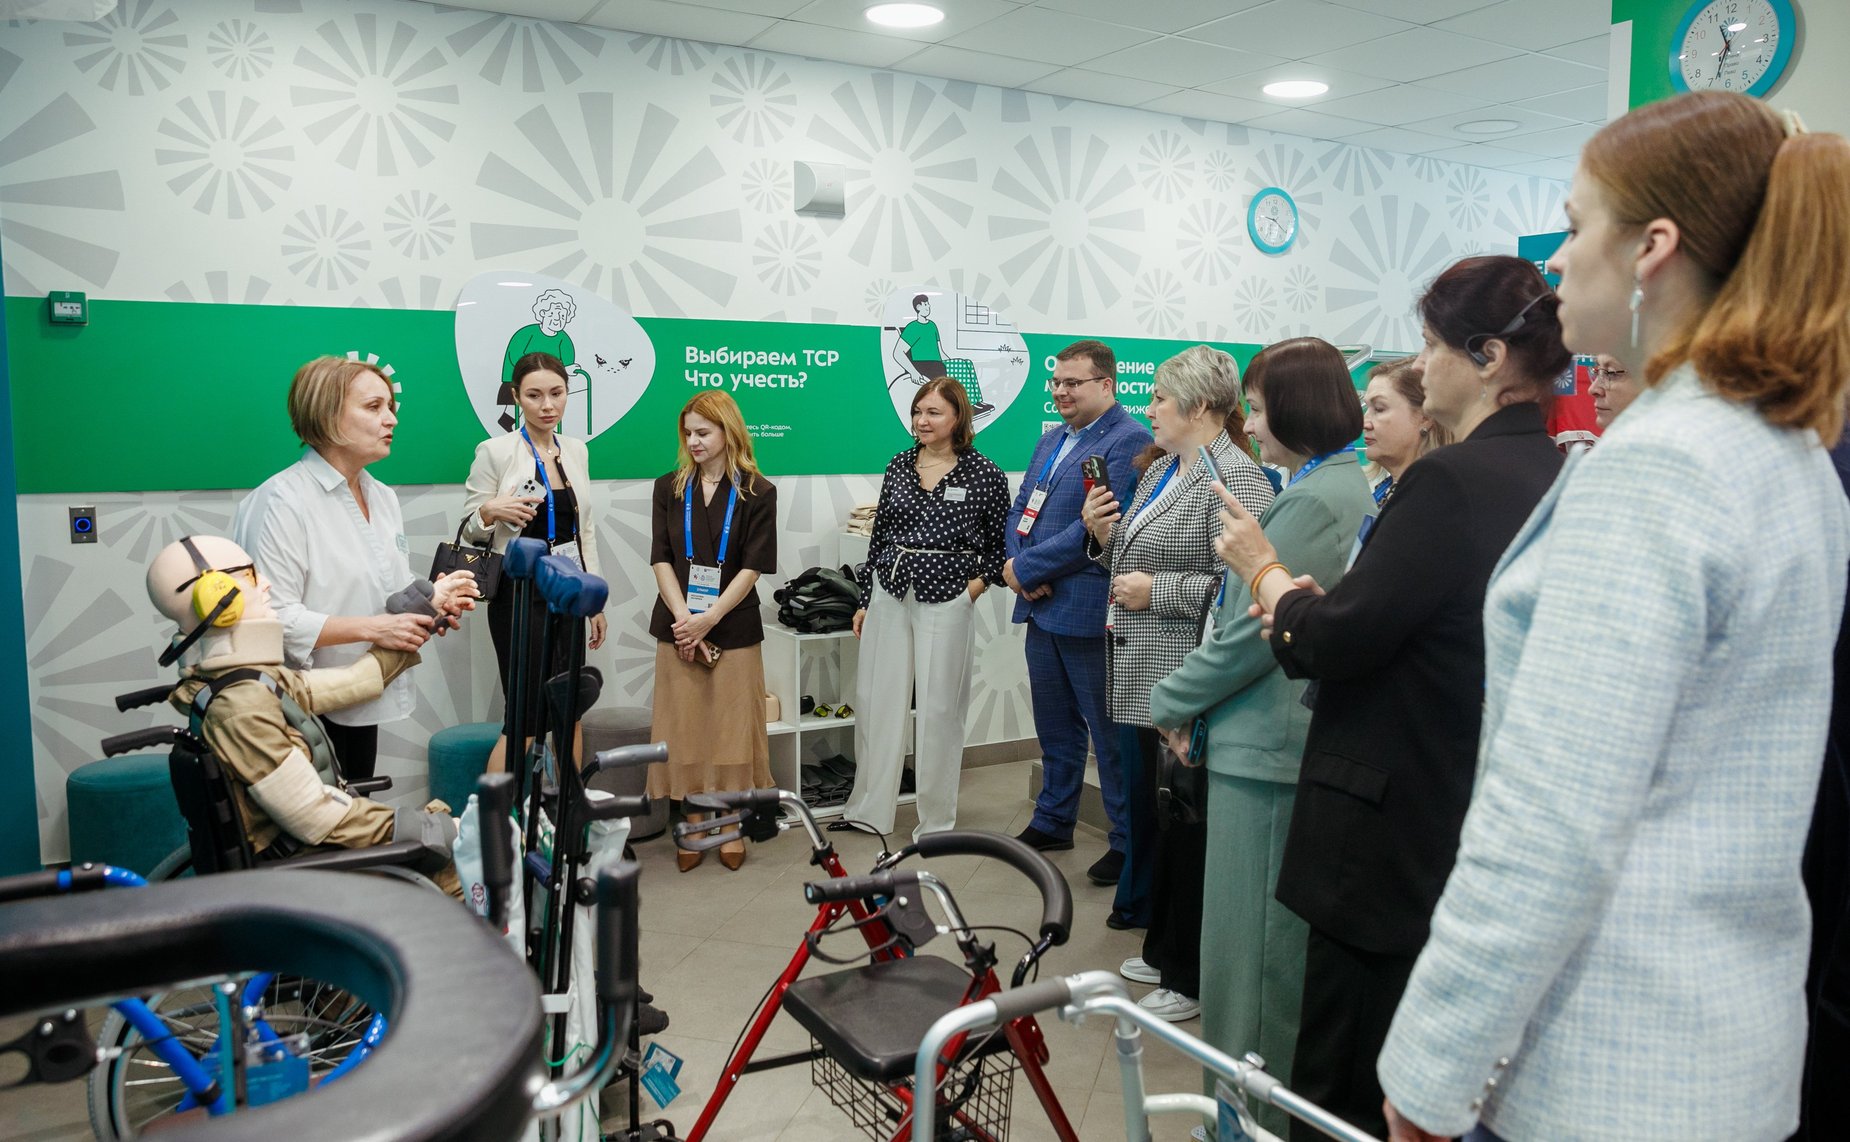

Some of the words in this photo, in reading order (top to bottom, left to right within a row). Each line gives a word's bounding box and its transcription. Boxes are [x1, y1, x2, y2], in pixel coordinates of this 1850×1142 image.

[1726, 3, 1738, 14] 12
[1708, 13, 1719, 24] 11
[1758, 16, 1765, 26] 2
[1695, 30, 1706, 40] 10
[1762, 34, 1769, 43] 3
[1691, 50, 1698, 59] 9
[1755, 55, 1762, 64] 4
[1695, 69, 1702, 78] 8
[1742, 70, 1748, 80] 5
[1707, 78, 1714, 88] 7
[1725, 79, 1731, 88] 6
[685, 346, 797, 369] Выбираем
[802, 349, 840, 367] ТСР
[684, 369, 724, 387] Что
[730, 371, 808, 392] учесть?
